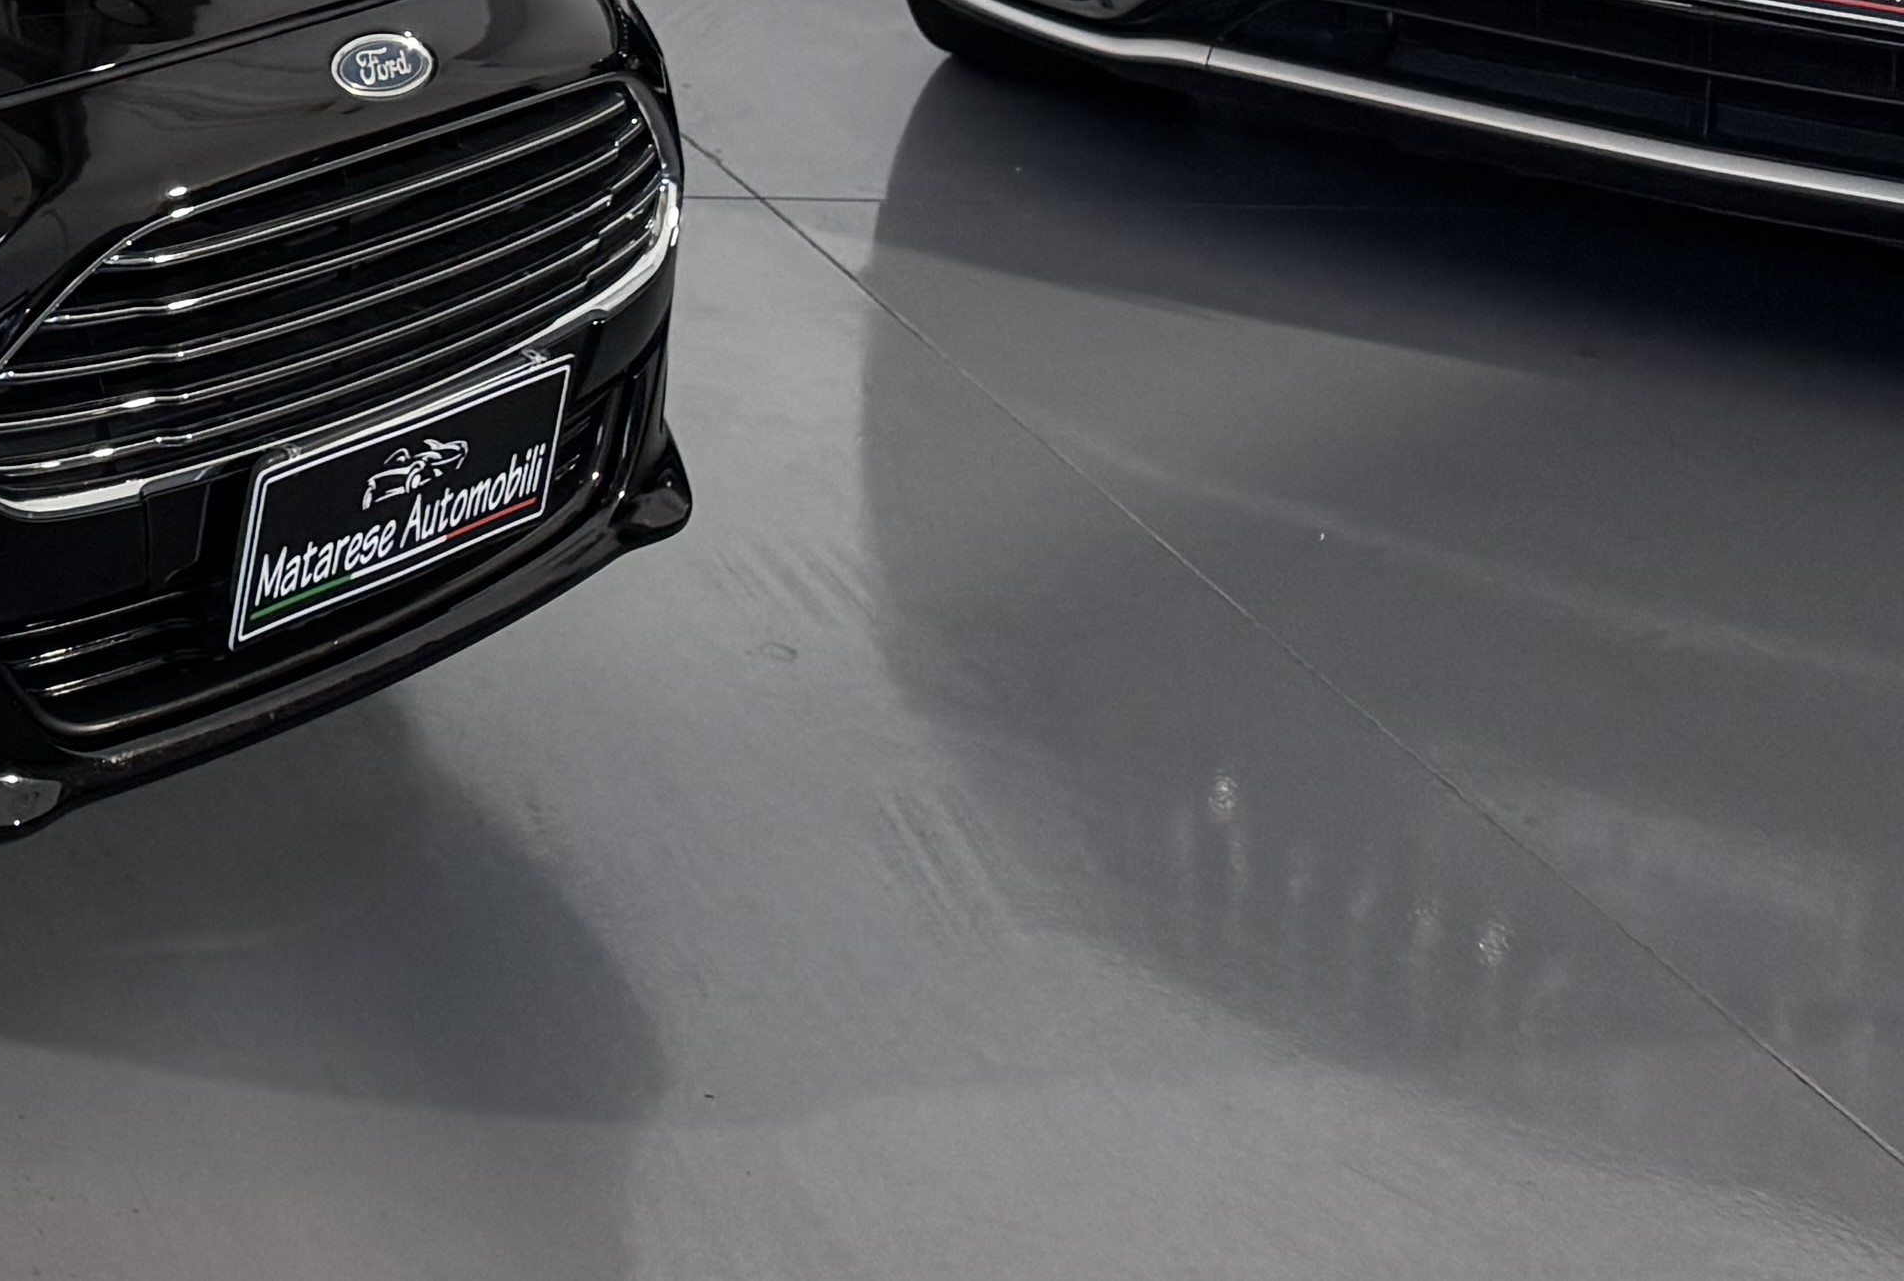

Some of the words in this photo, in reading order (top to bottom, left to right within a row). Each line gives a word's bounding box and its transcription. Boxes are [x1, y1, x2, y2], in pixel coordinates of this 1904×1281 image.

[355, 46, 411, 86] Ford
[254, 519, 397, 607] Matarese
[399, 443, 546, 550] Automobili
